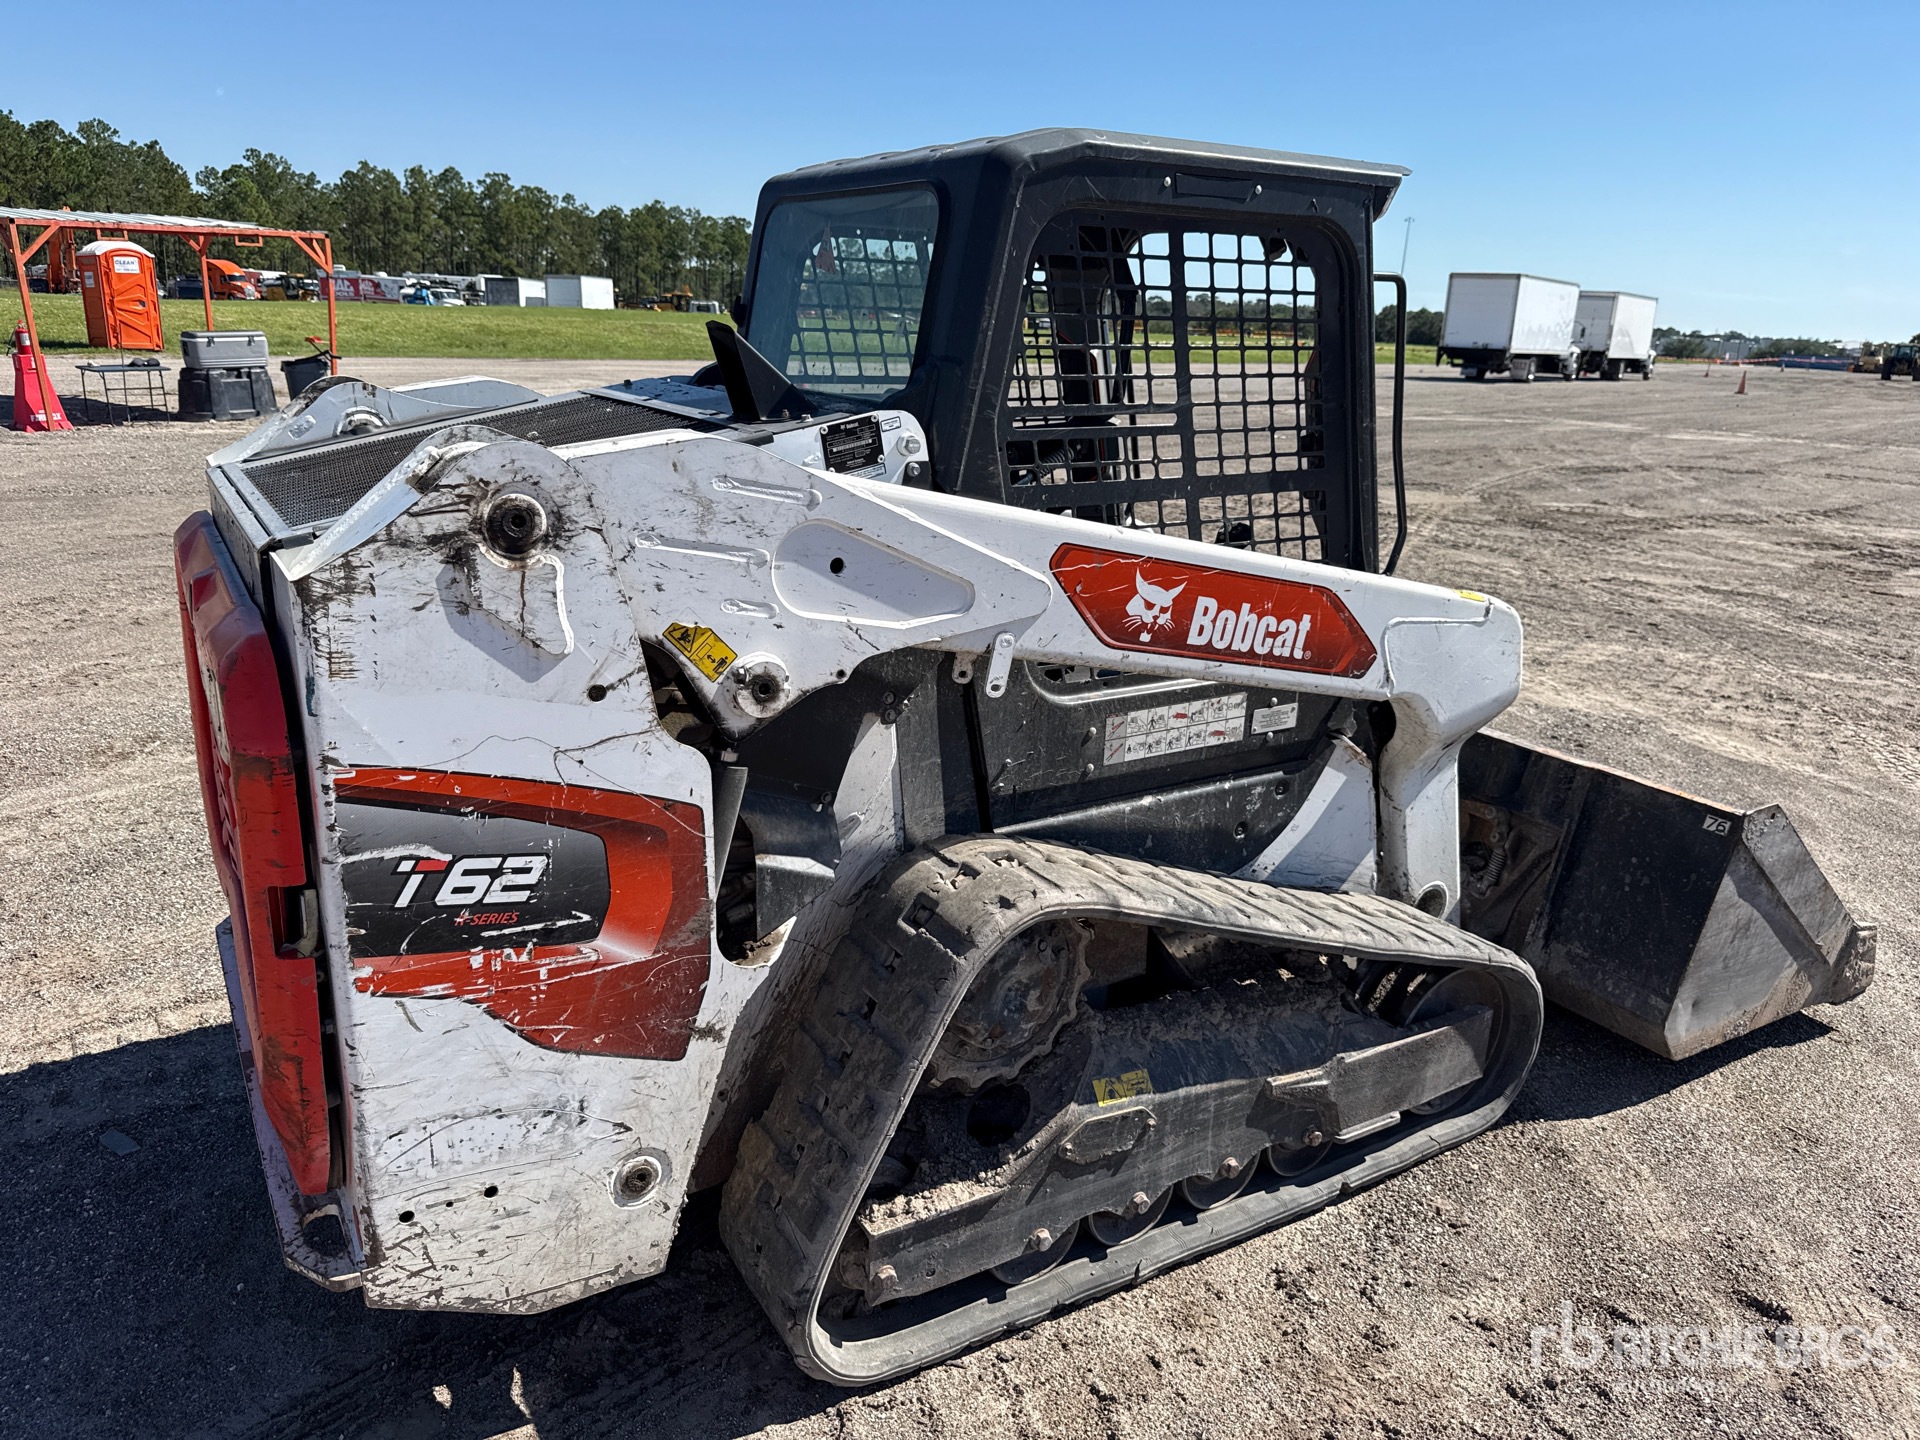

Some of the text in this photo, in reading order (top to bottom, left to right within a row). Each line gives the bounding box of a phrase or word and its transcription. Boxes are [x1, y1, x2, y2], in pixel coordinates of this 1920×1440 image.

[1186, 595, 1312, 660] Bobcat
[1706, 816, 1728, 833] 76
[394, 855, 548, 908] T62
